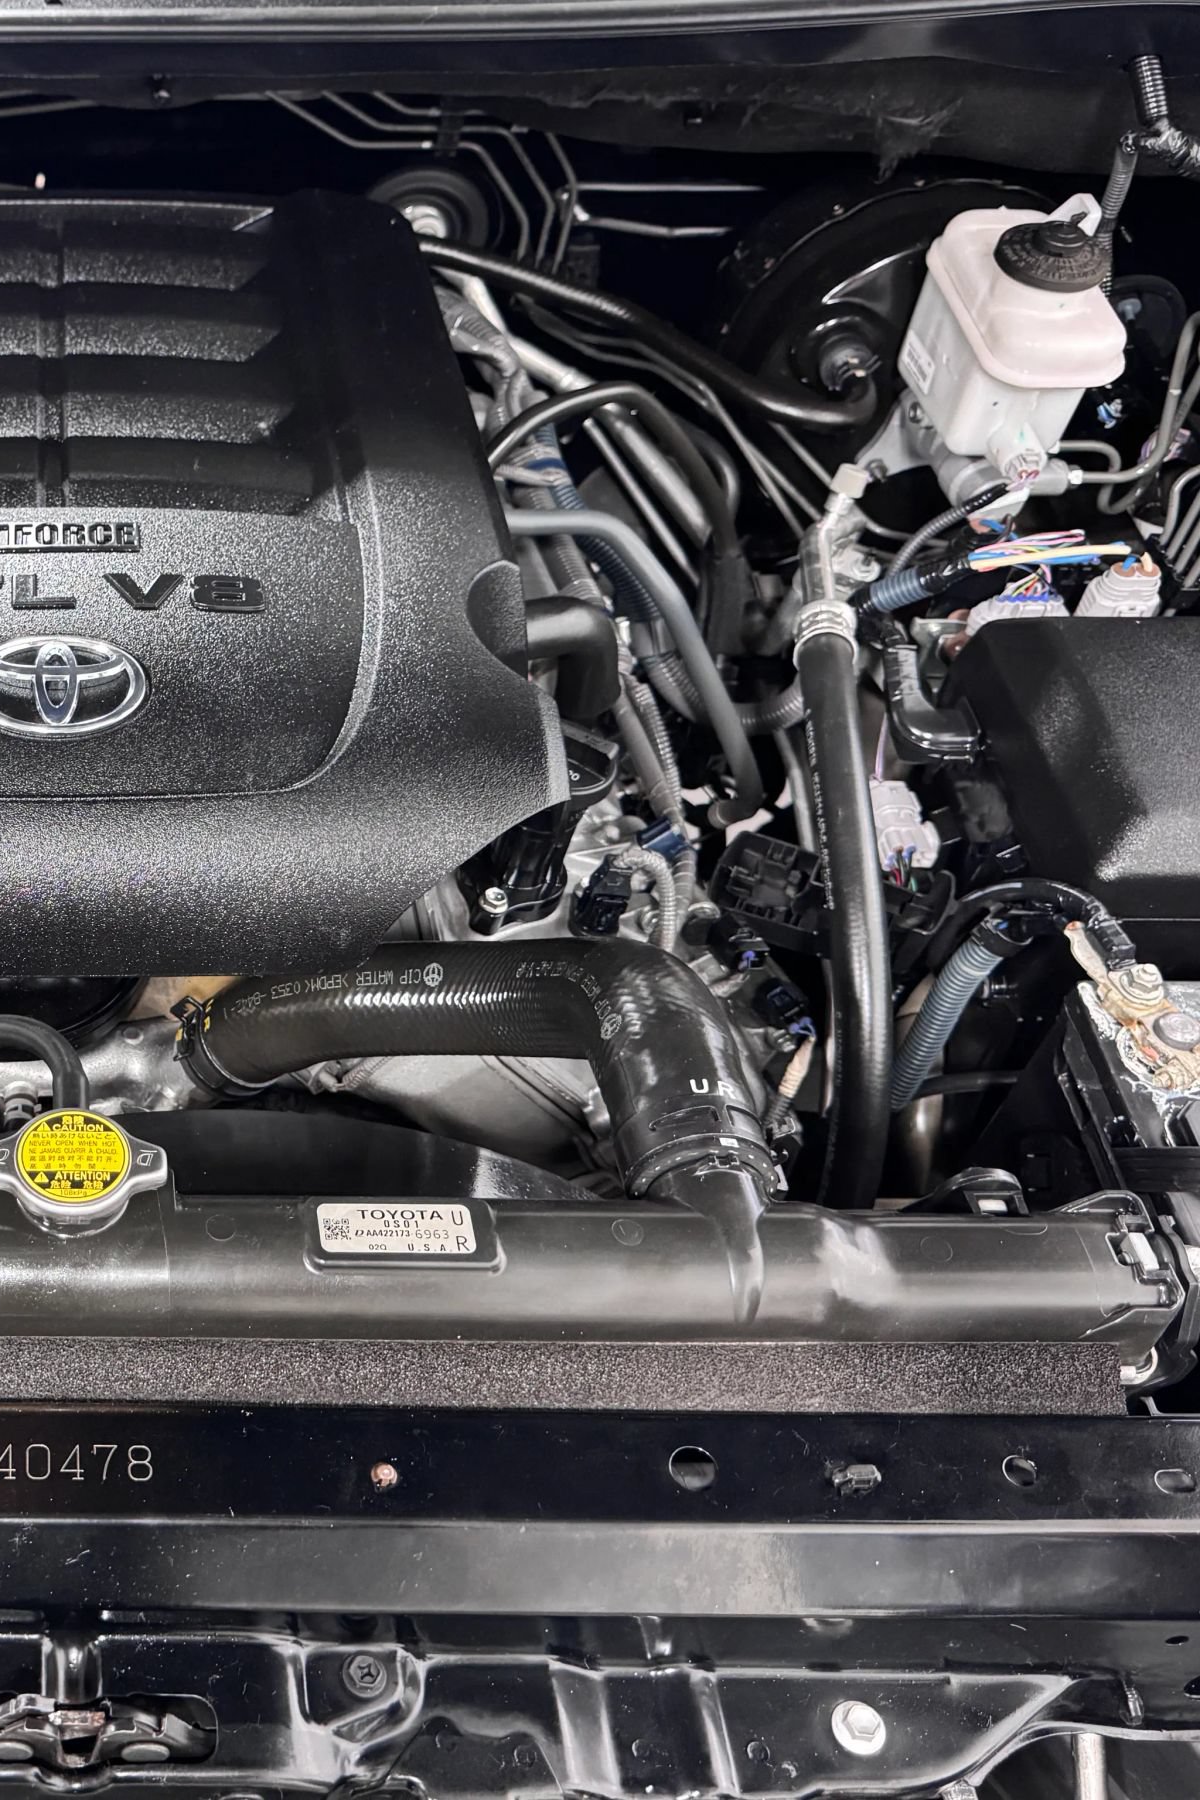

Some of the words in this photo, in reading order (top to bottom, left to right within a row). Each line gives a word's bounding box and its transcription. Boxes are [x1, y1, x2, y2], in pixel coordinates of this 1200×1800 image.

[103, 572, 266, 613] V8
[356, 970, 394, 987] WATER
[400, 969, 421, 984] CIP
[52, 1123, 104, 1132] CAUTION
[54, 1171, 111, 1181] ATTENTION
[357, 1209, 444, 1221] TOYOTA
[451, 1210, 464, 1226] U
[456, 1235, 470, 1252] R
